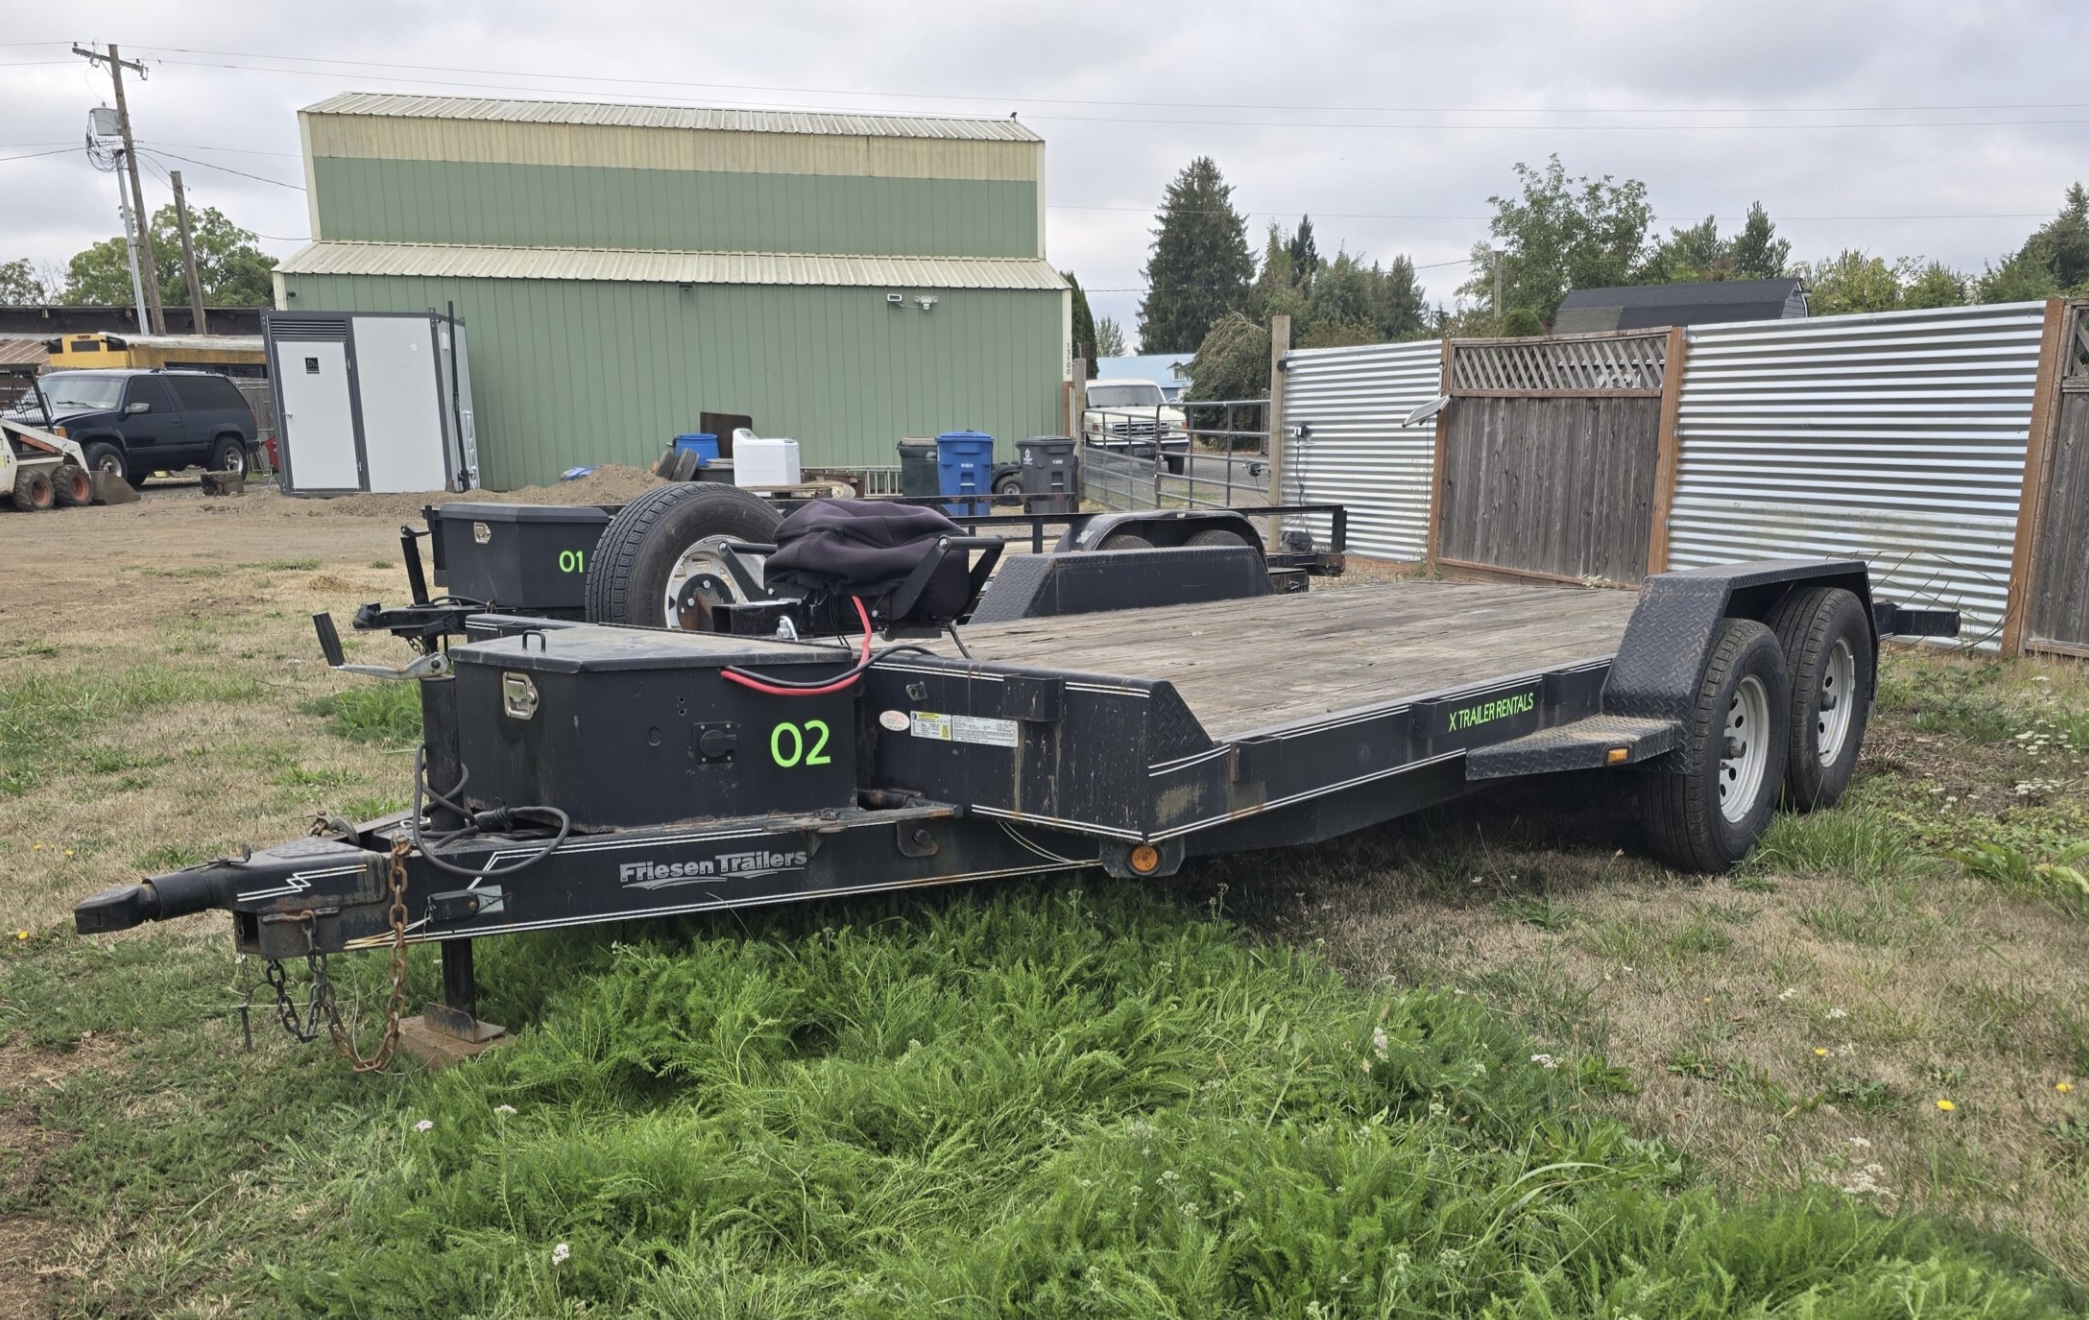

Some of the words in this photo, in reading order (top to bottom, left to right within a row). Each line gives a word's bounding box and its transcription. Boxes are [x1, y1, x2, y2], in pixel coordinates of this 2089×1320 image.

[559, 550, 584, 573] 01
[1448, 711, 1457, 732] X
[1458, 702, 1495, 729] TRAILER
[1496, 692, 1534, 719] RENTALS
[771, 719, 831, 768] 02
[619, 861, 715, 883] Friesen
[714, 851, 808, 872] Trailers
